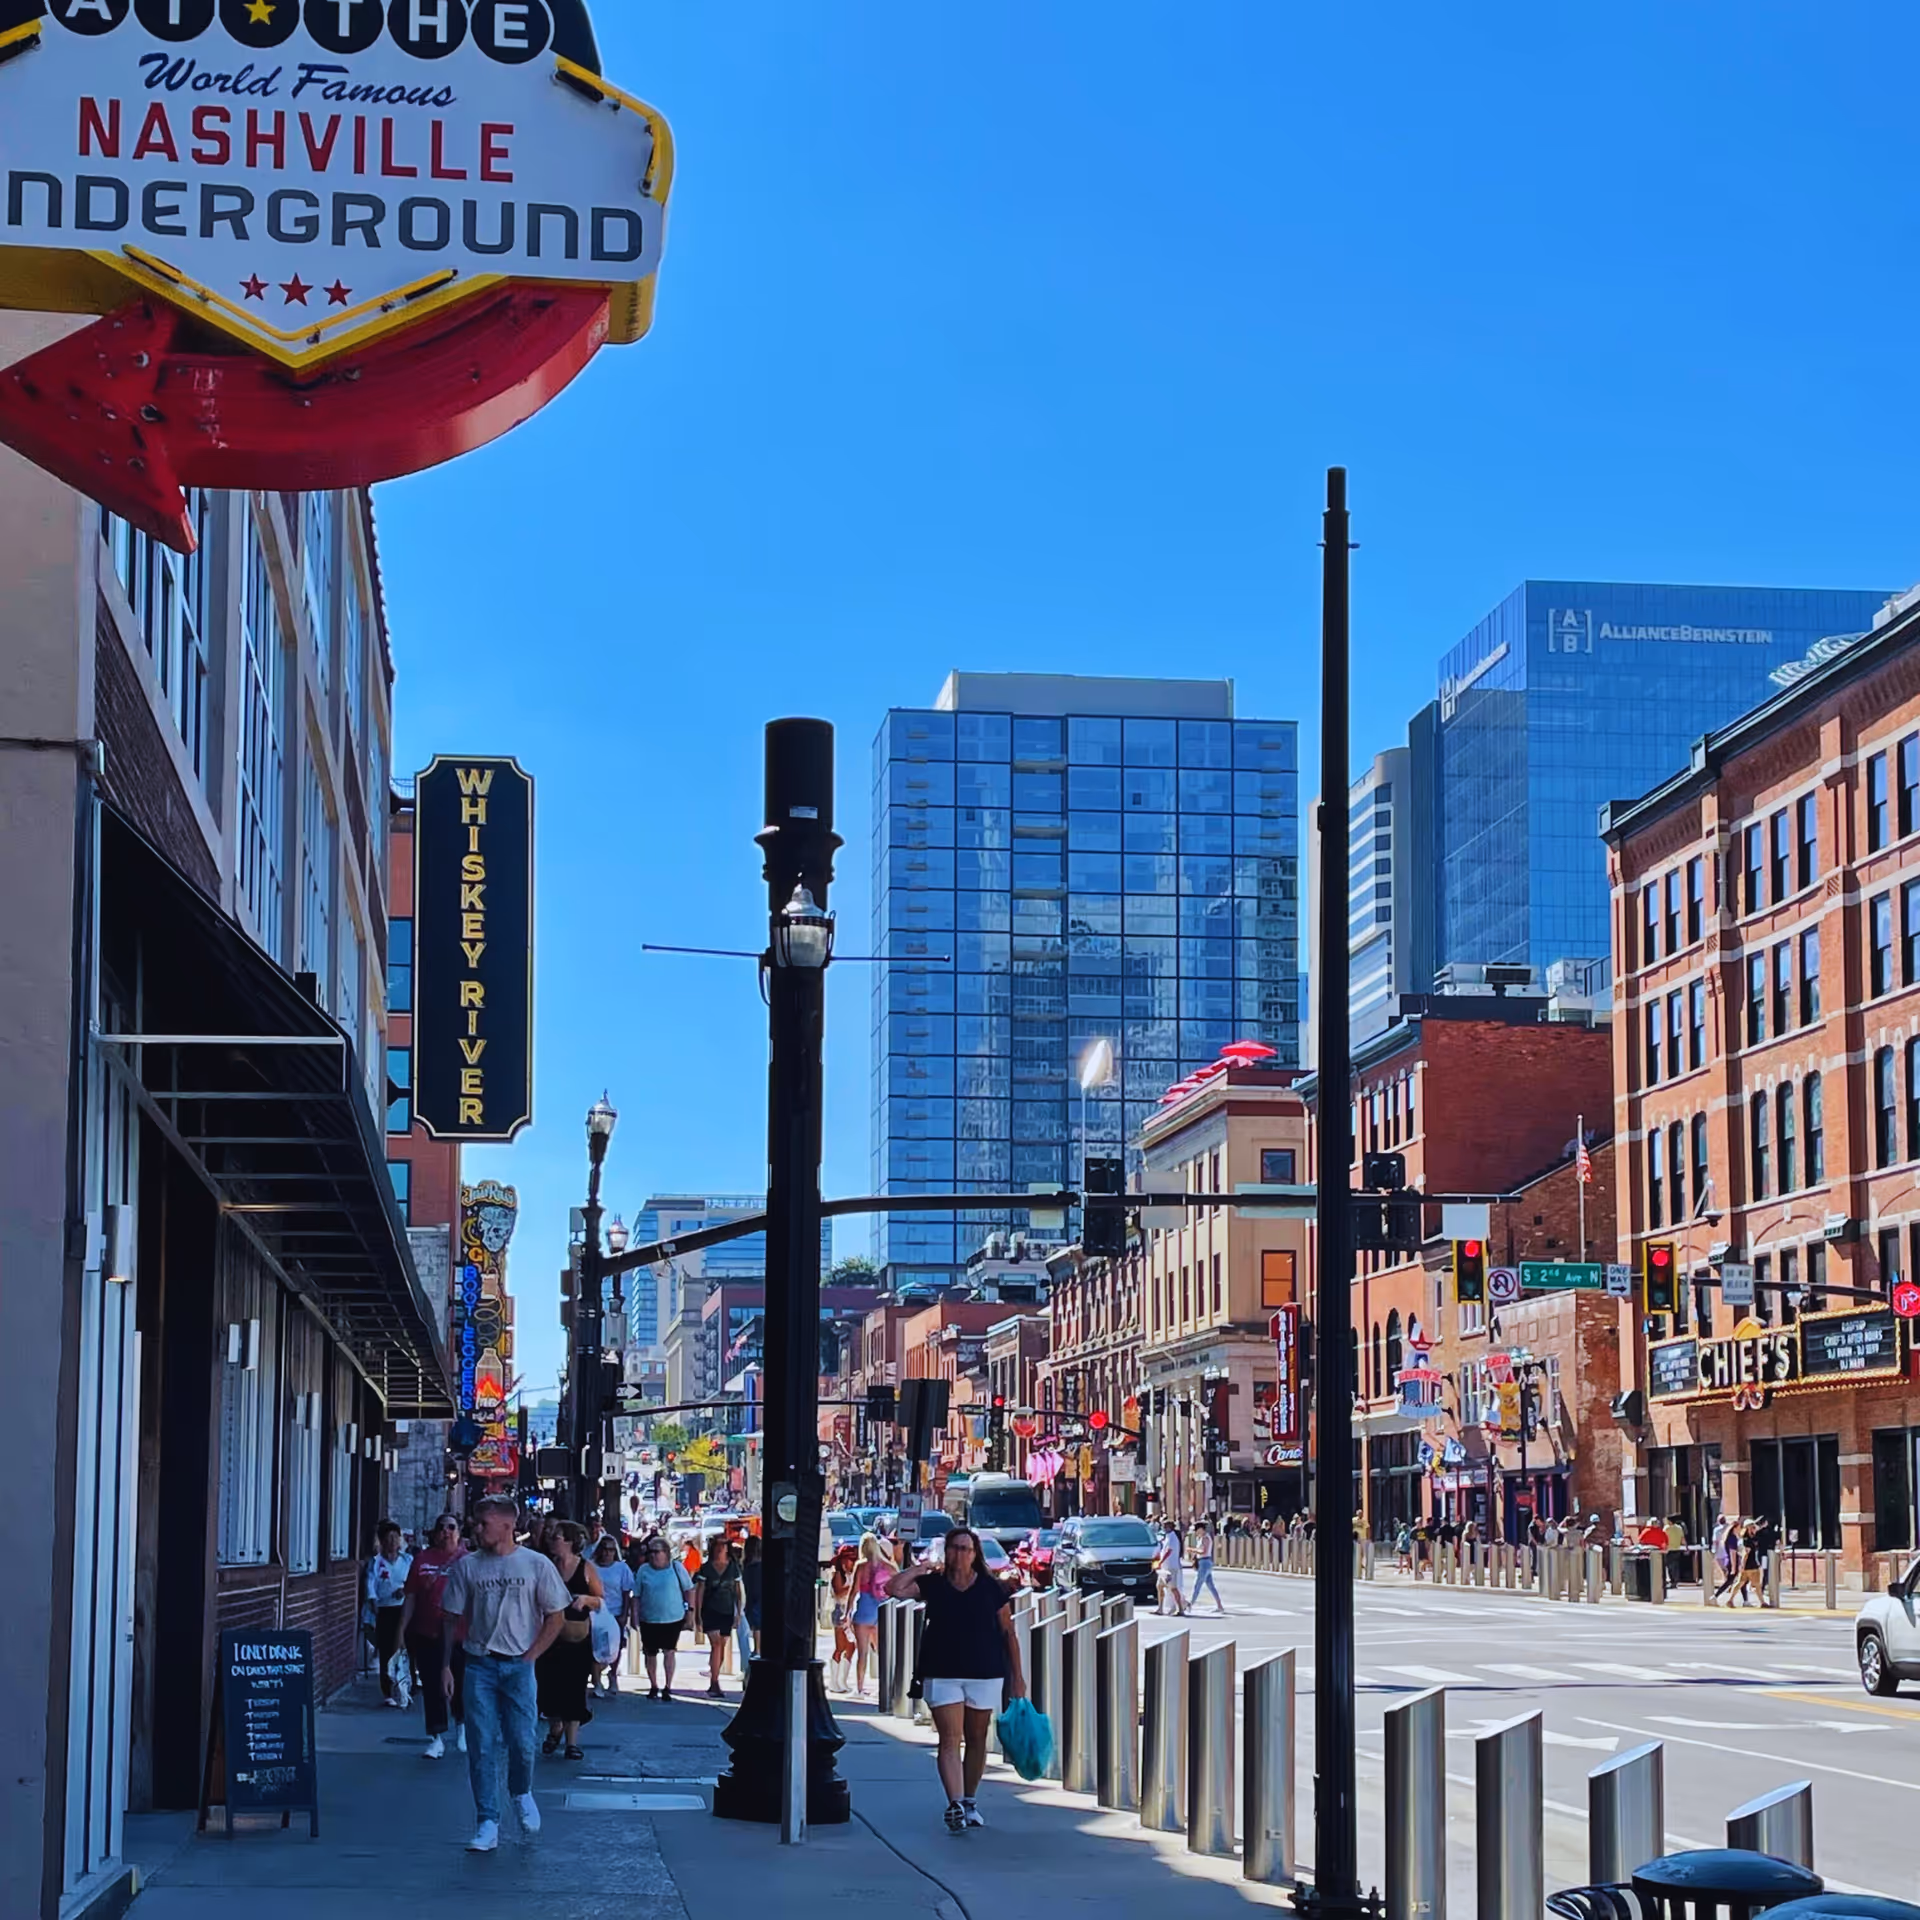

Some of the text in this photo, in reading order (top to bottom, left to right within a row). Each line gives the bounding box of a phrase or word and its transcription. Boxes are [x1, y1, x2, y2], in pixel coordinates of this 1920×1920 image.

[326, 0, 529, 48] THE
[138, 52, 457, 107] World Famous
[78, 97, 515, 182] NASHVILLE
[455, 768, 495, 1125] WHISKEY RIVER
[1523, 1267, 1531, 1283] S
[1565, 1272, 1582, 1283] Ave
[1589, 1270, 1598, 1284] N
[1609, 1266, 1628, 1276] ONE
[1609, 1275, 1629, 1285] WAY
[461, 1265, 480, 1410] BOOTLEGGERS
[1698, 1335, 1790, 1388] CHIEF'S
[231, 1665, 245, 1676] ON
[241, 1644, 267, 1660] ONLY
[269, 1645, 302, 1660] DRINK
